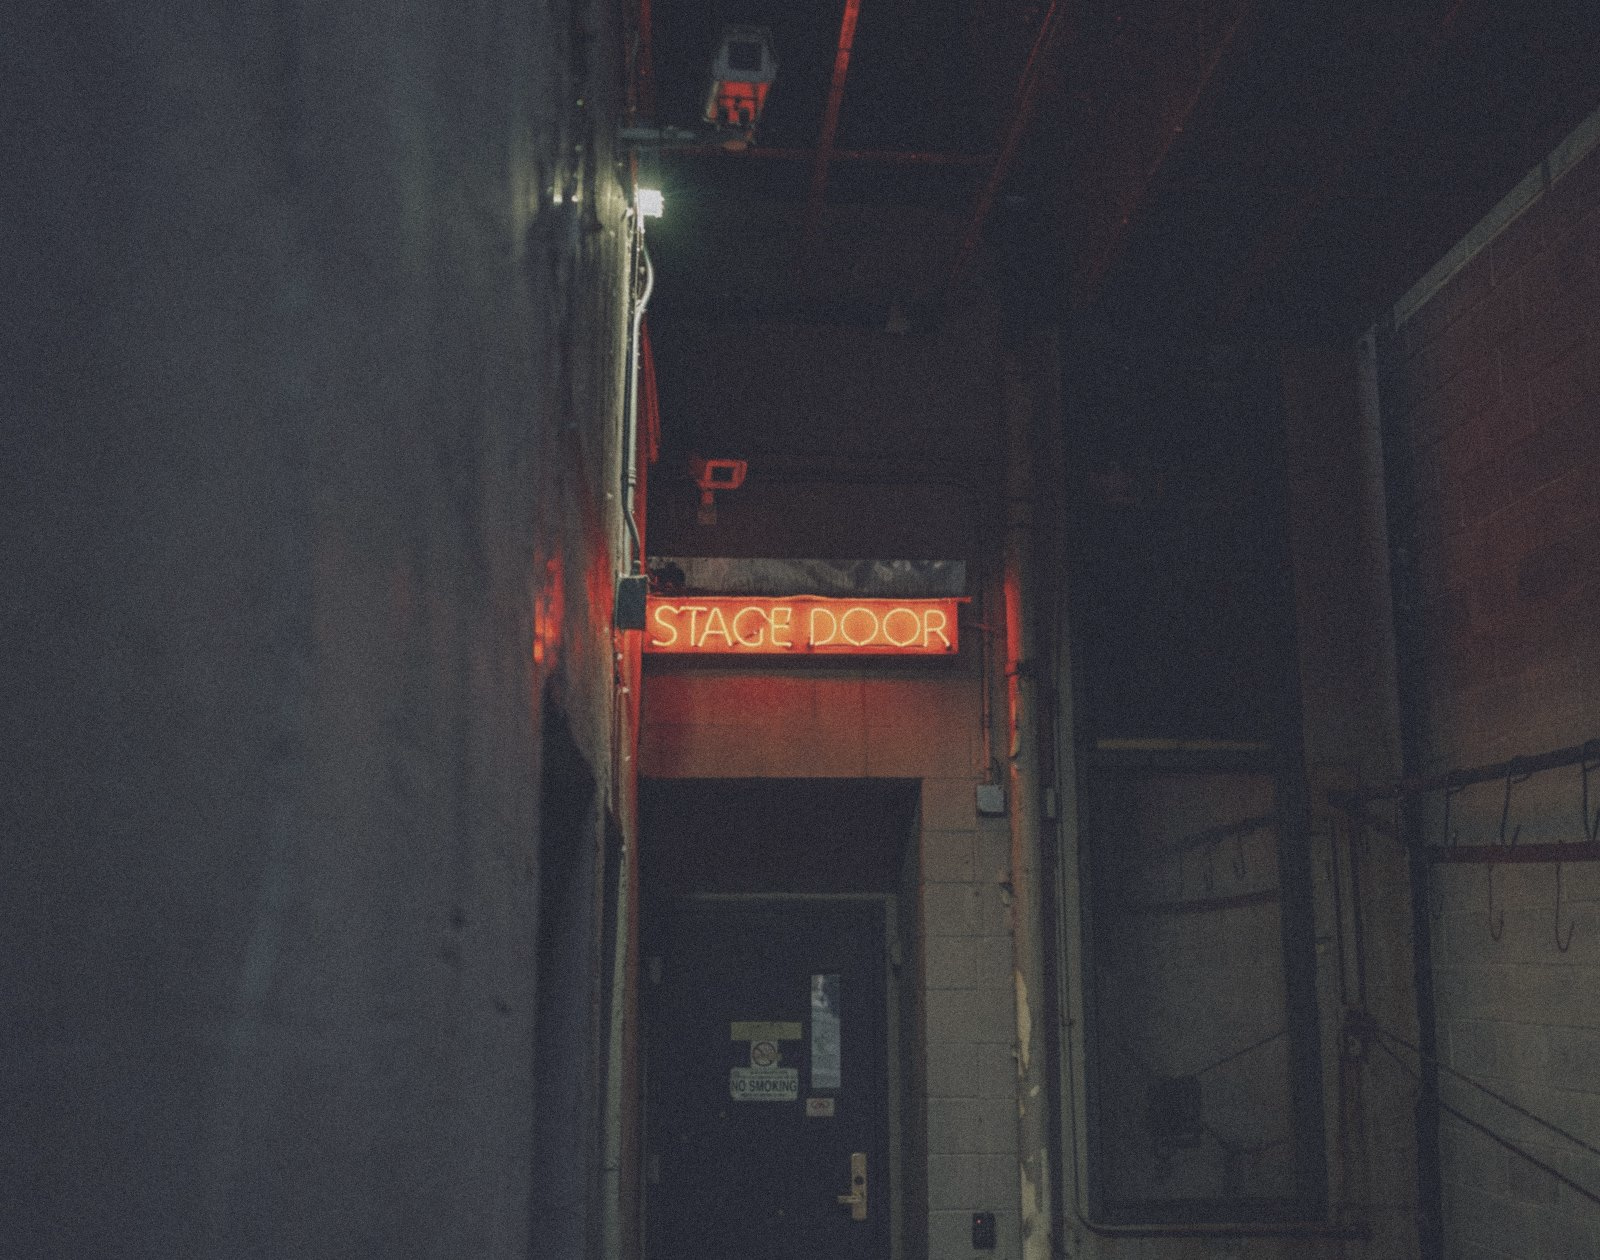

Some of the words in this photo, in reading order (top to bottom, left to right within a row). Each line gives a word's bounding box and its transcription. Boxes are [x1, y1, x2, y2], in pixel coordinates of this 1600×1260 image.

[651, 604, 793, 648] STAGE
[809, 606, 951, 648] DOOR
[731, 1080, 747, 1092] NO
[749, 1080, 797, 1092] SMOKING
